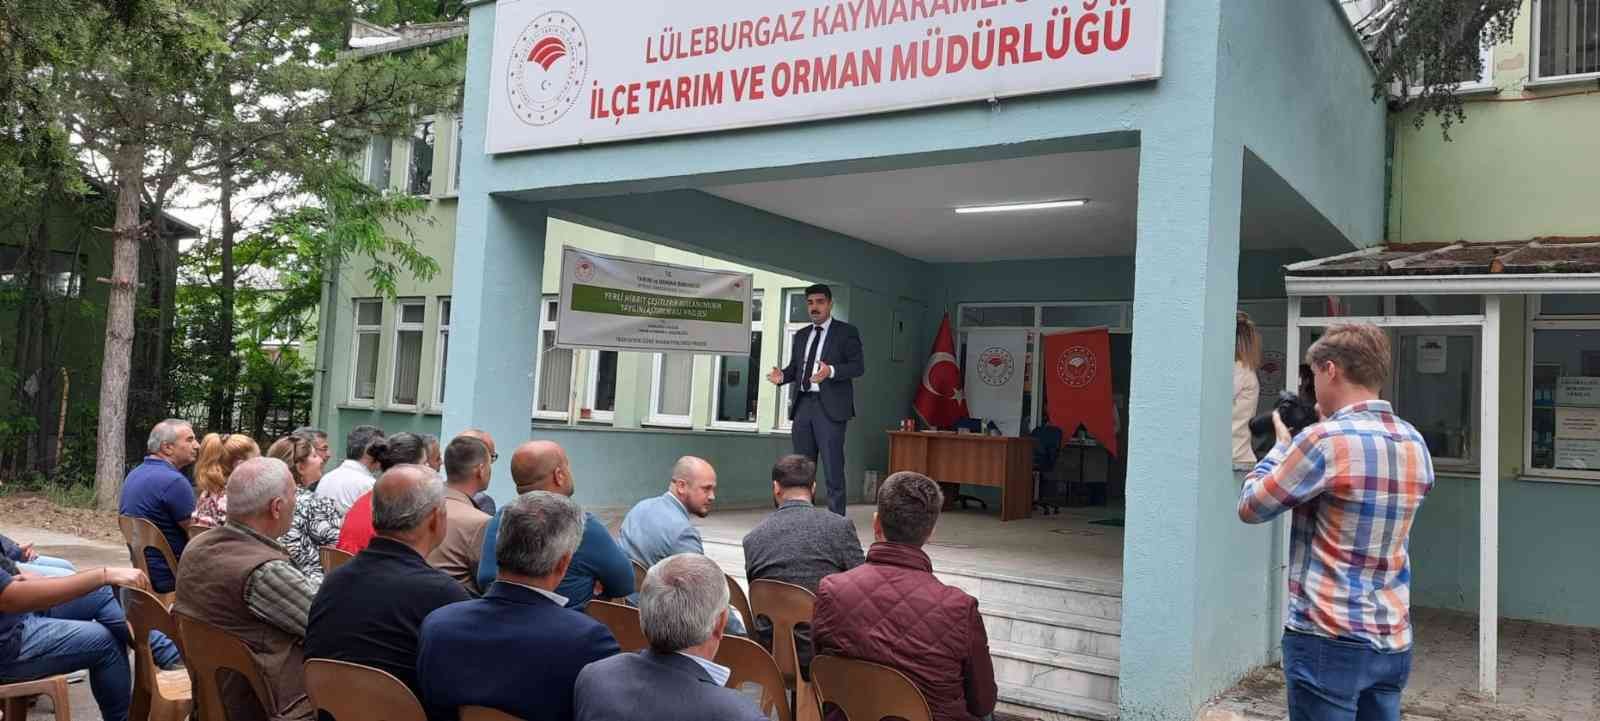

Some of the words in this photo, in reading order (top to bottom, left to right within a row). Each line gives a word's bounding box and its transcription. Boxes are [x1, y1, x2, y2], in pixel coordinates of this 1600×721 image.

[589, 79, 641, 124] İLÇE
[647, 71, 724, 112] TARIM
[729, 65, 766, 102] VE
[770, 47, 882, 98] ORMAN
[889, 0, 1132, 81] MÜDÜRLÜĞÜ
[645, 6, 807, 64] LÜLEBURGAZ
